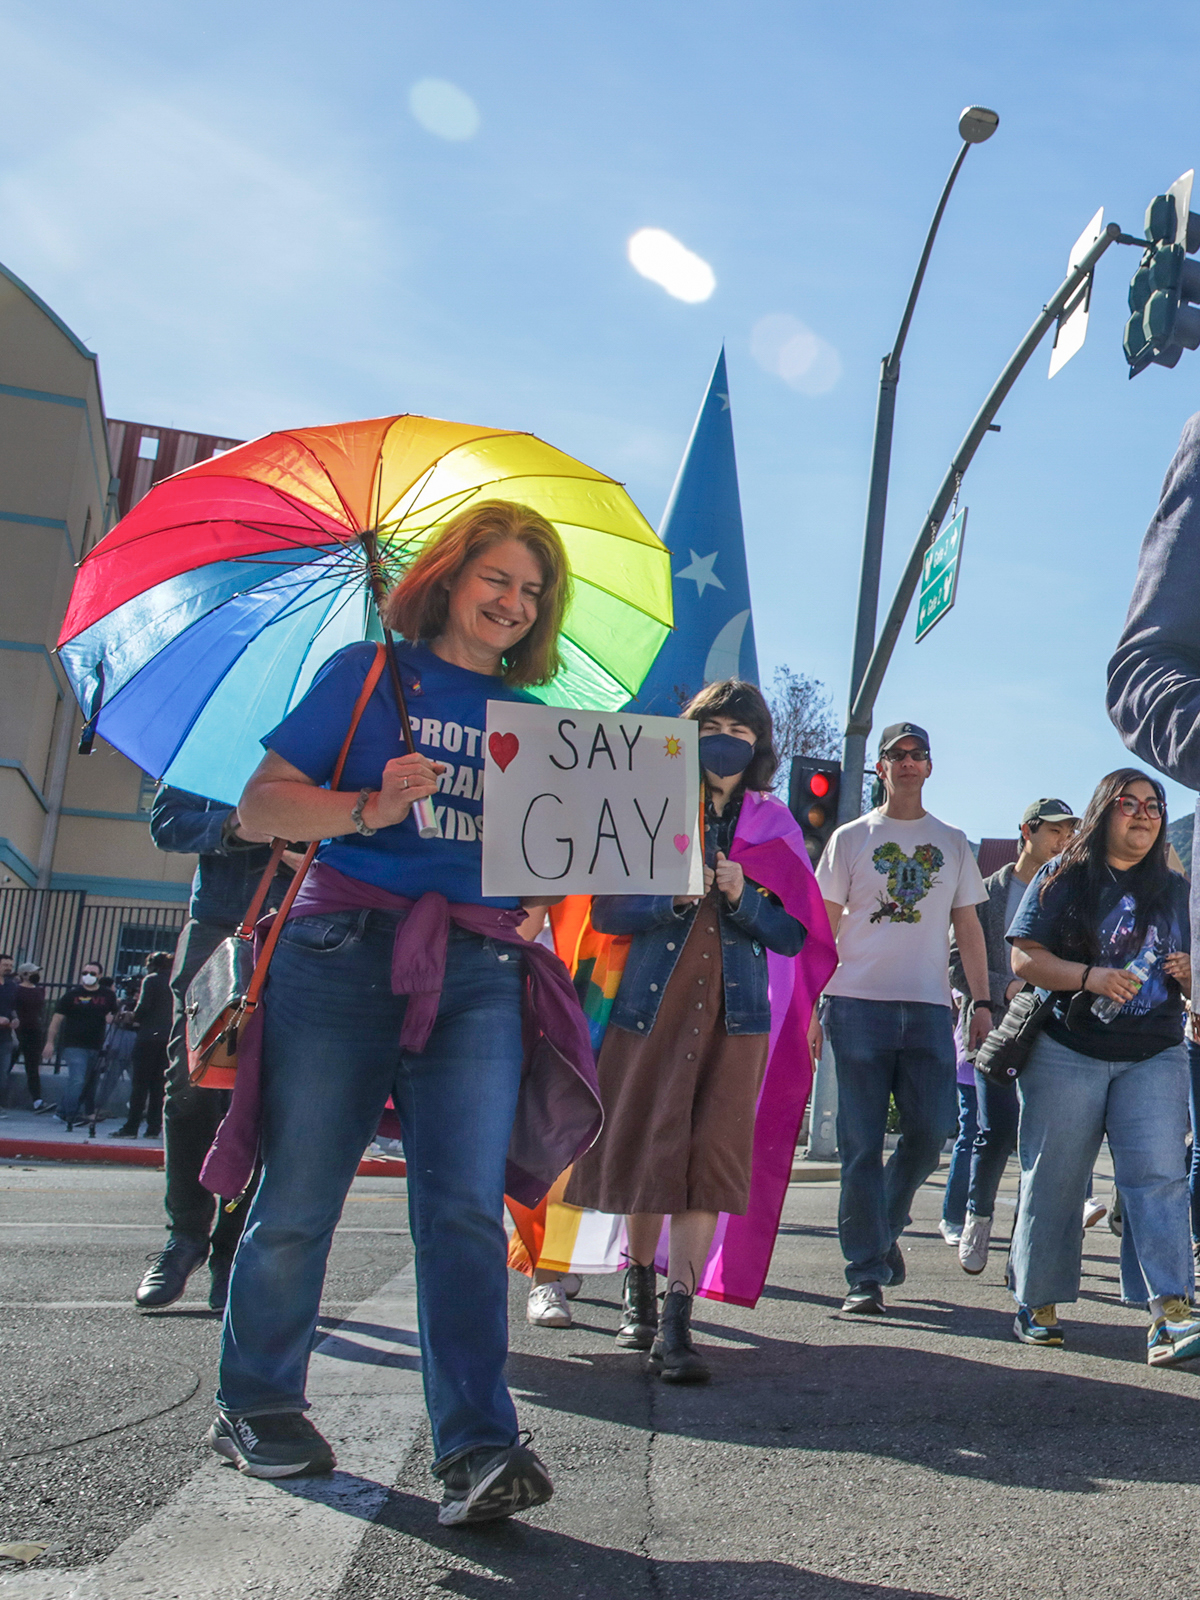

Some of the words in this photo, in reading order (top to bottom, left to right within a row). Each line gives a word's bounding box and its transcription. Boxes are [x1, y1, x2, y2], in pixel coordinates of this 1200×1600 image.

[548, 718, 643, 771] SAY
[425, 758, 484, 801] RA
[521, 792, 670, 880] GAY
